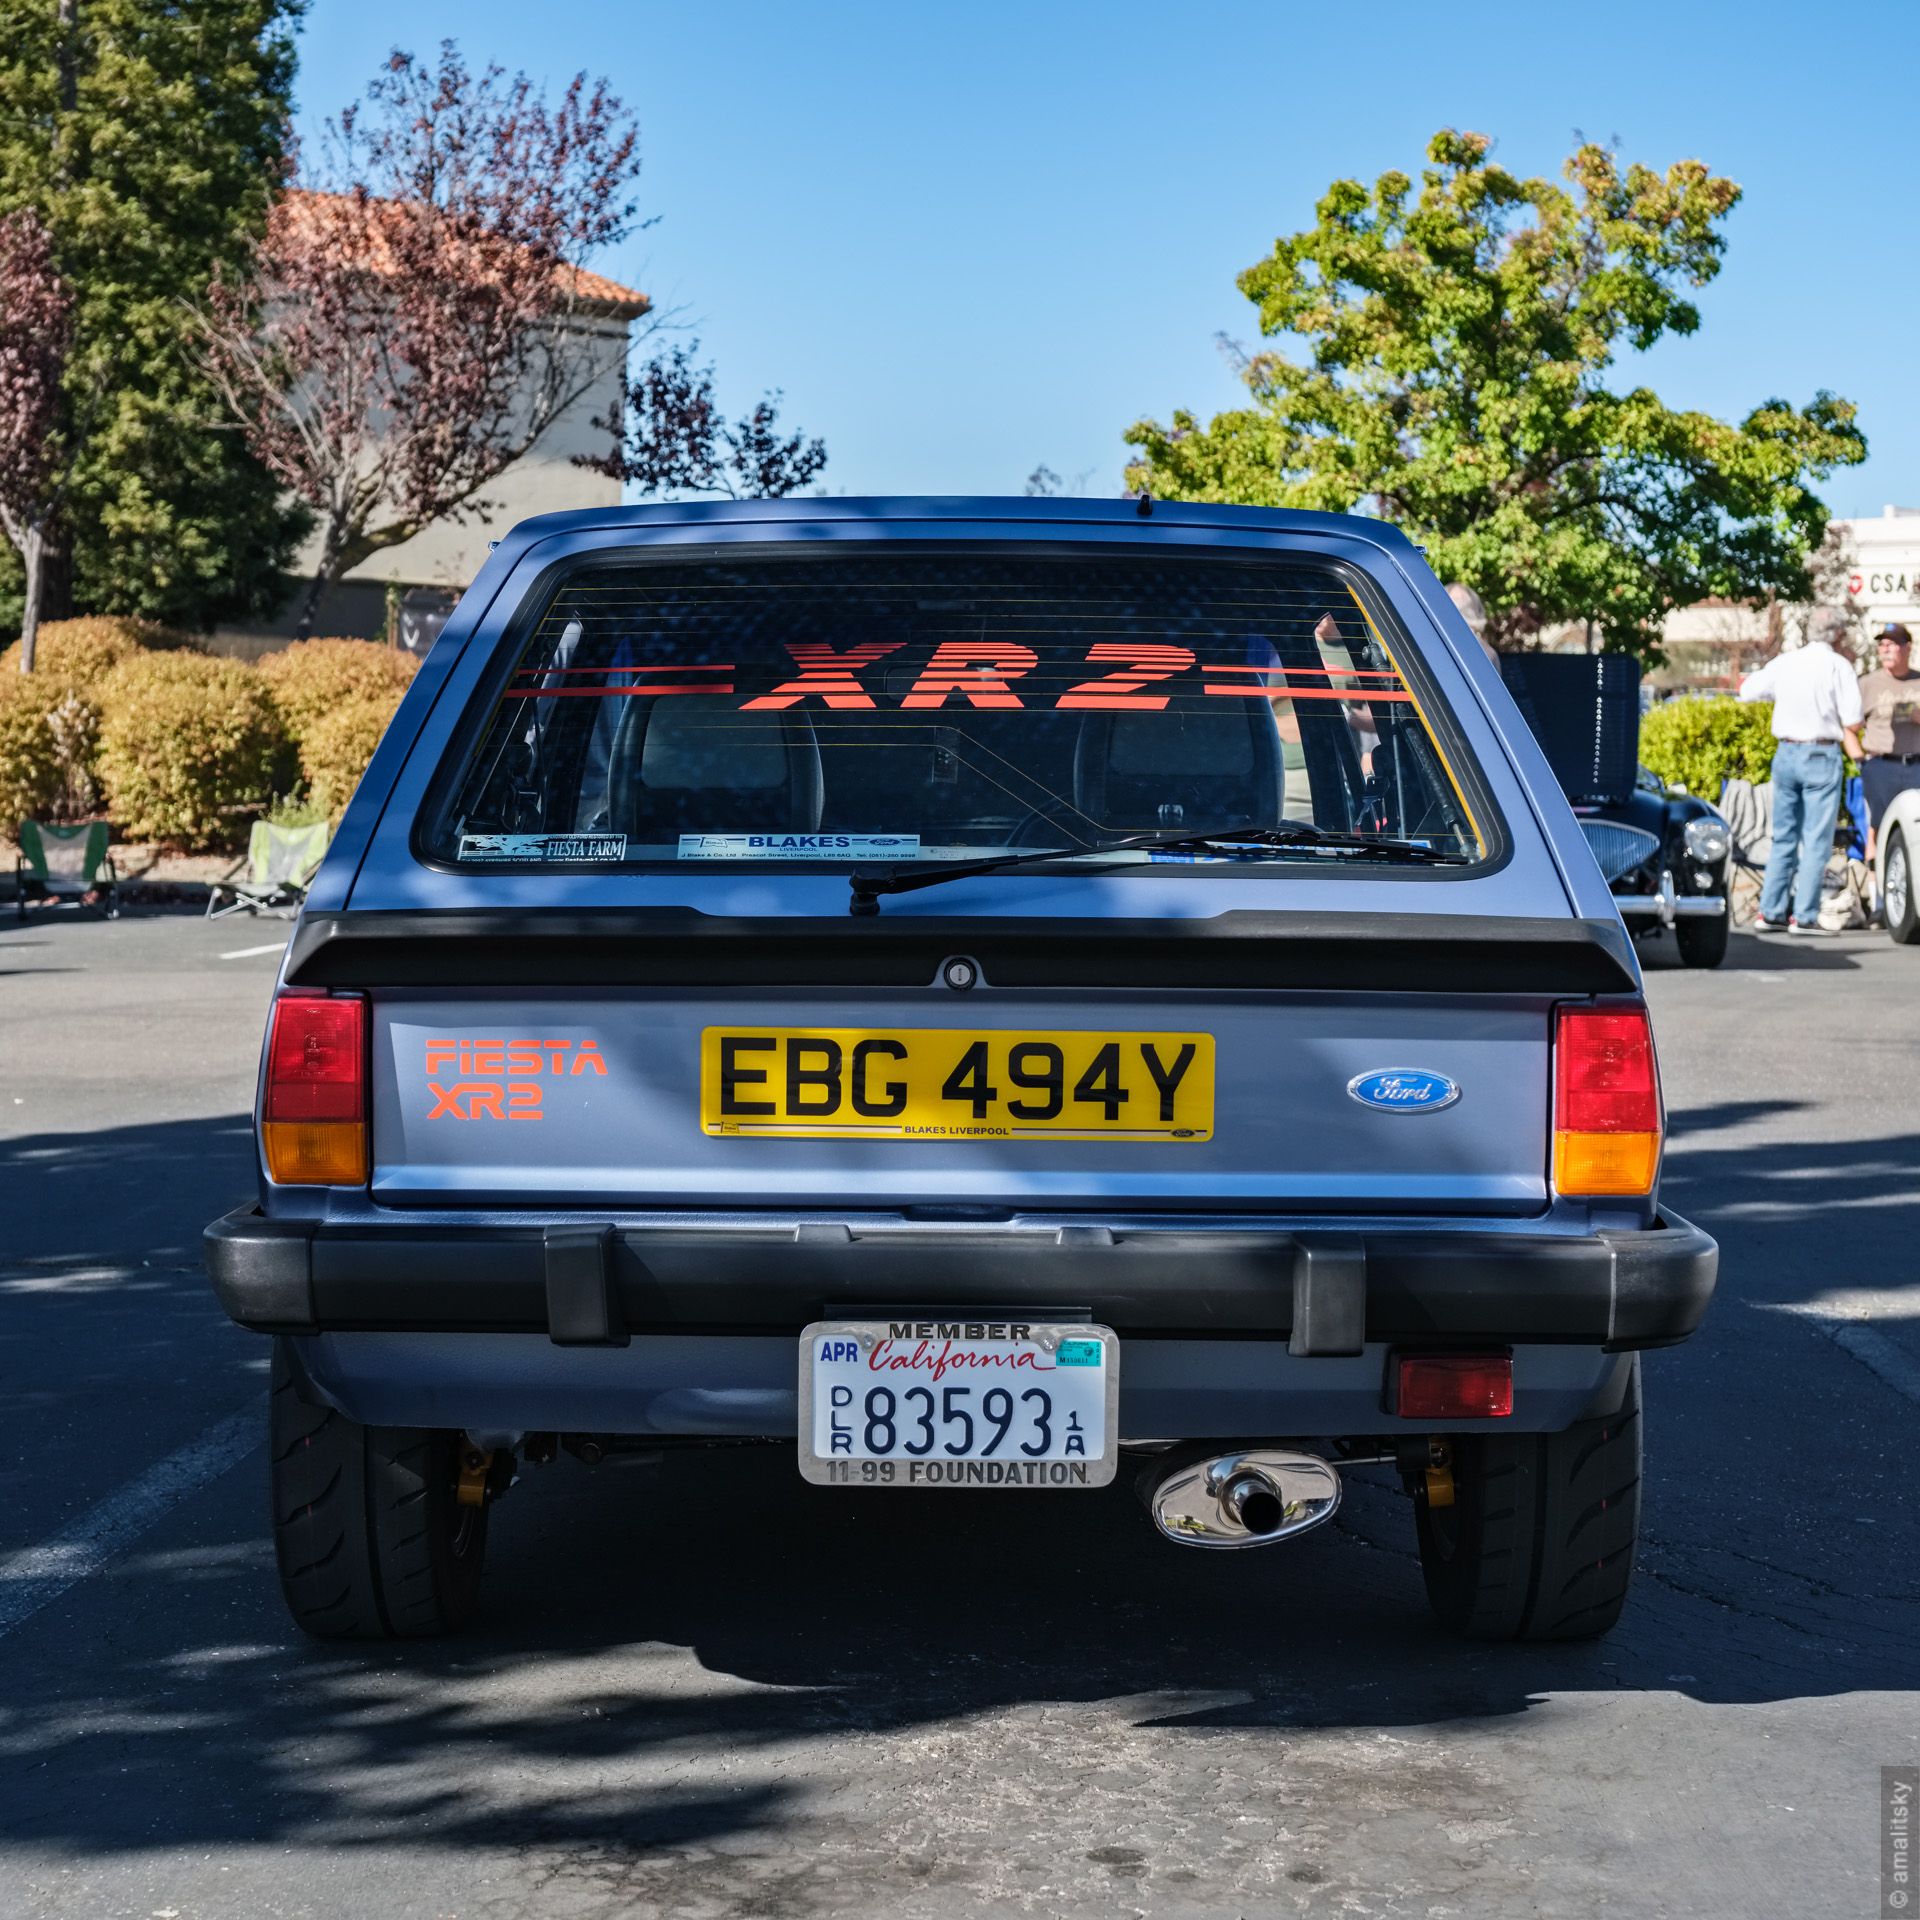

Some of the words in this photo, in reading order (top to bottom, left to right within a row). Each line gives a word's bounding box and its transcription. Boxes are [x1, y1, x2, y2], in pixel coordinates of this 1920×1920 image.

[738, 642, 1196, 711] XR2
[546, 840, 587, 857] FIESTA
[588, 841, 623, 857] FARM
[748, 836, 850, 848] BLAKES
[425, 1039, 609, 1076] FIESTA
[719, 1036, 909, 1118] EBG
[941, 1040, 1197, 1123] 494Y
[1373, 1076, 1434, 1101] Ford
[426, 1082, 544, 1121] XR2
[904, 1125, 947, 1135] BLAKES
[949, 1126, 1009, 1136] LIVERPOOL
[888, 1322, 1032, 1341] MEMBER
[820, 1341, 858, 1363] APR
[868, 1339, 1057, 1382] California
[863, 1385, 1053, 1457] 83593
